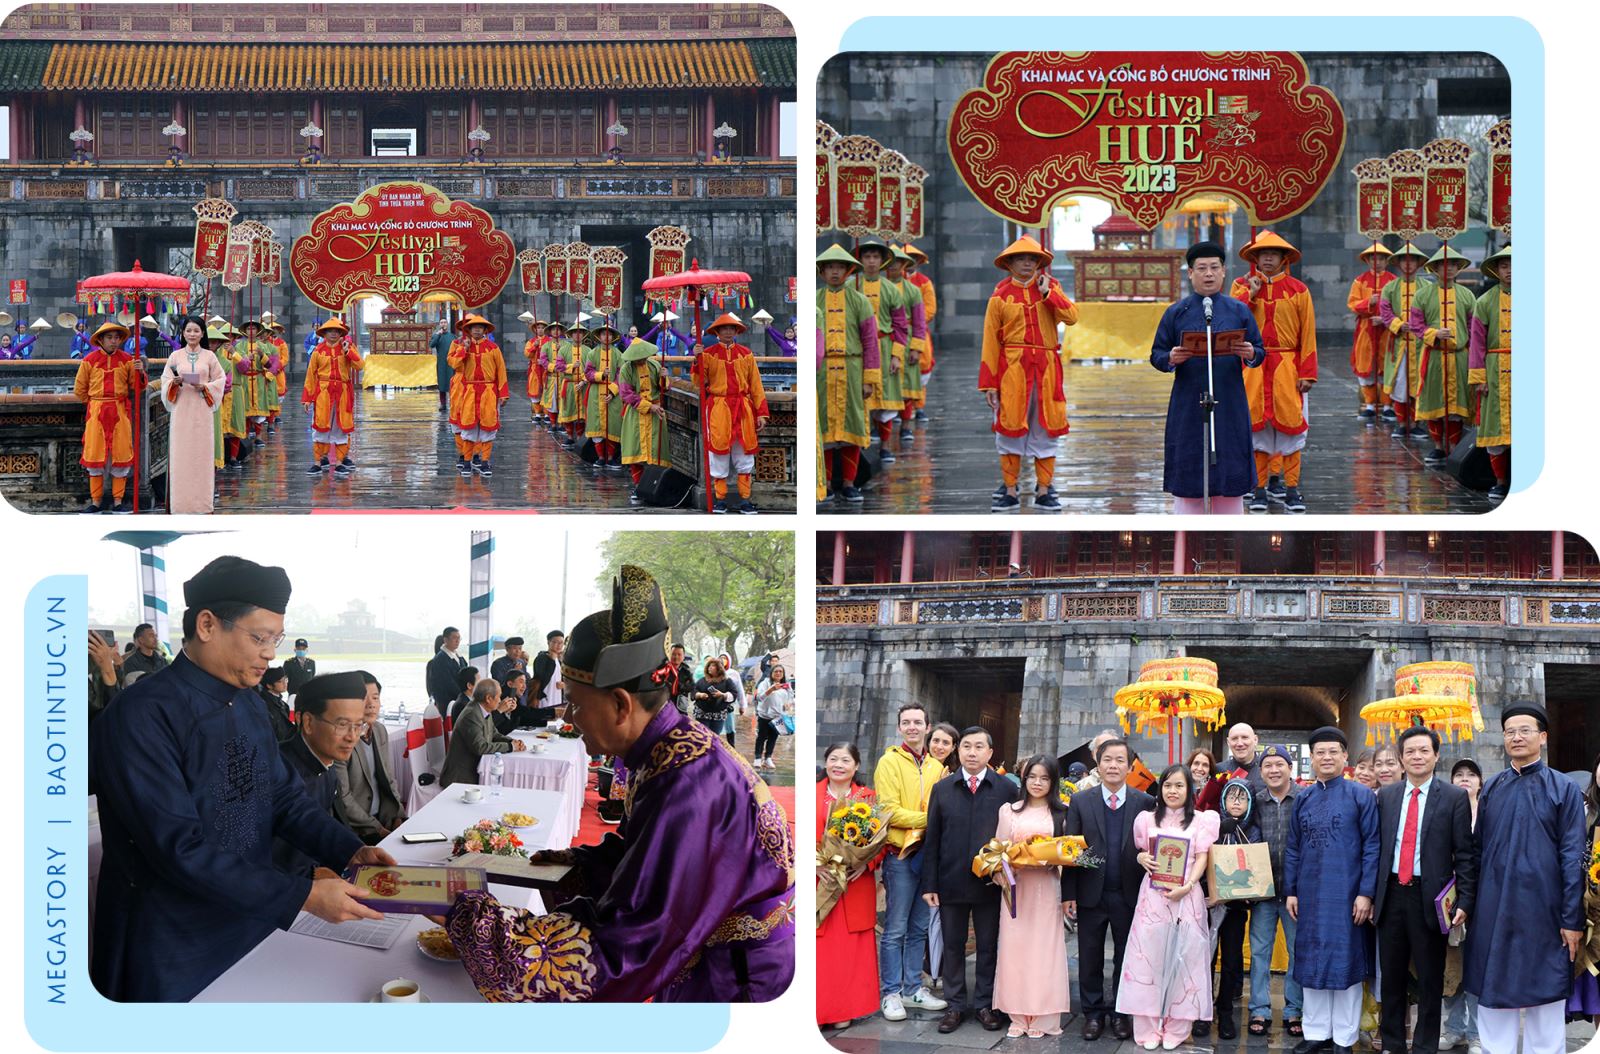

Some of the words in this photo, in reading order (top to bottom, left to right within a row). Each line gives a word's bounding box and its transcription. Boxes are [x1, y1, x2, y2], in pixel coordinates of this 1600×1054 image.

[1021, 70, 1053, 82] KHAI
[1056, 70, 1084, 85] MẠC
[1087, 68, 1105, 82] VÀ
[1109, 66, 1147, 82] CÔNG
[1150, 65, 1168, 82] BỐ
[1171, 69, 1228, 82] CHƯƠNG
[1231, 68, 1271, 82] TRÌNH
[1016, 63, 1216, 138] Festival
[1096, 117, 1204, 165] HUẾ
[1122, 165, 1177, 194] 2023
[351, 223, 367, 231] MẠC
[380, 220, 402, 230] CÔNG
[416, 221, 449, 229] CHƯƠNG
[450, 220, 473, 229] TRÌNH
[328, 218, 442, 263] Festival
[374, 248, 437, 277] HUẾ
[389, 276, 421, 293] 2023
